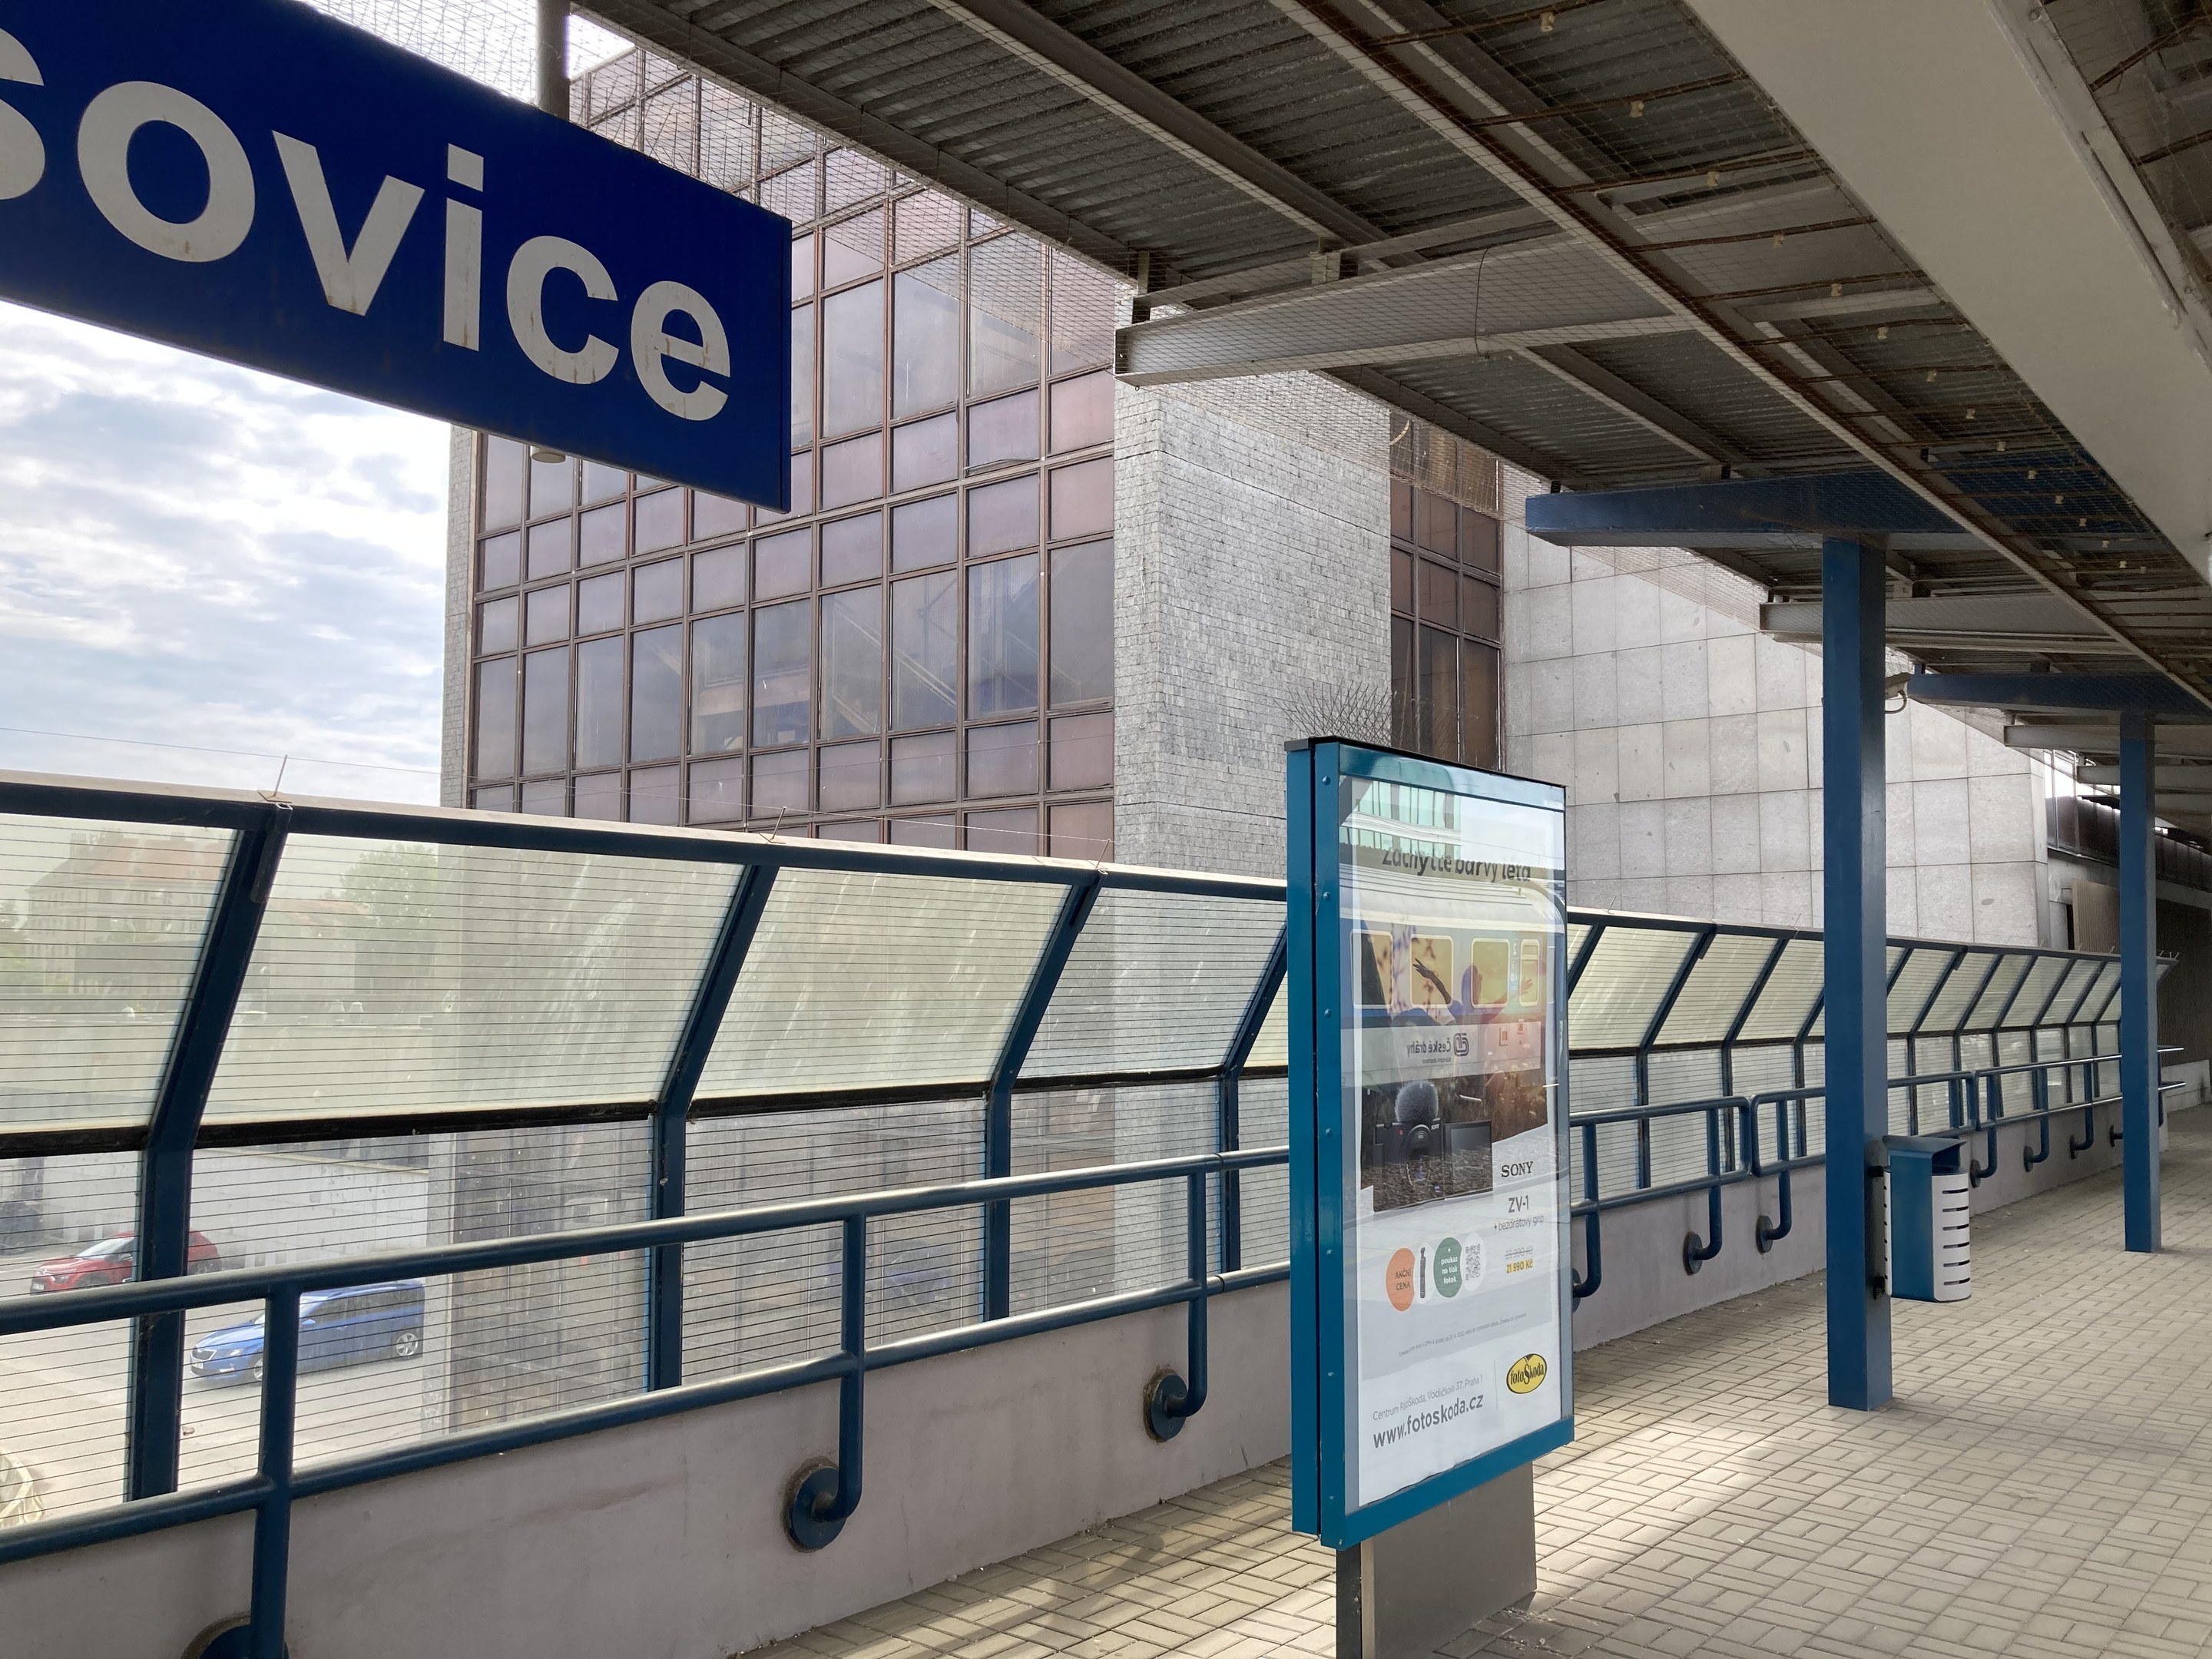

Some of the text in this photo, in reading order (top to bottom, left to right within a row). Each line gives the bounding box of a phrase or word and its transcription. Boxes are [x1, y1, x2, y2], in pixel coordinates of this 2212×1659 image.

[1501, 1161, 1534, 1178] SONY
[1508, 1194, 1529, 1214] ZV-1
[1441, 1257, 1458, 1267] poukaz
[1506, 1258, 1533, 1274] 21 990 Kč
[1396, 1280, 1411, 1291] CENA
[1443, 1276, 1457, 1284] fotek
[1373, 1406, 1399, 1421] Centrum
[1464, 1376, 1480, 1389] Praha
[1373, 1394, 1484, 1449] www.fotoskoda.cz
